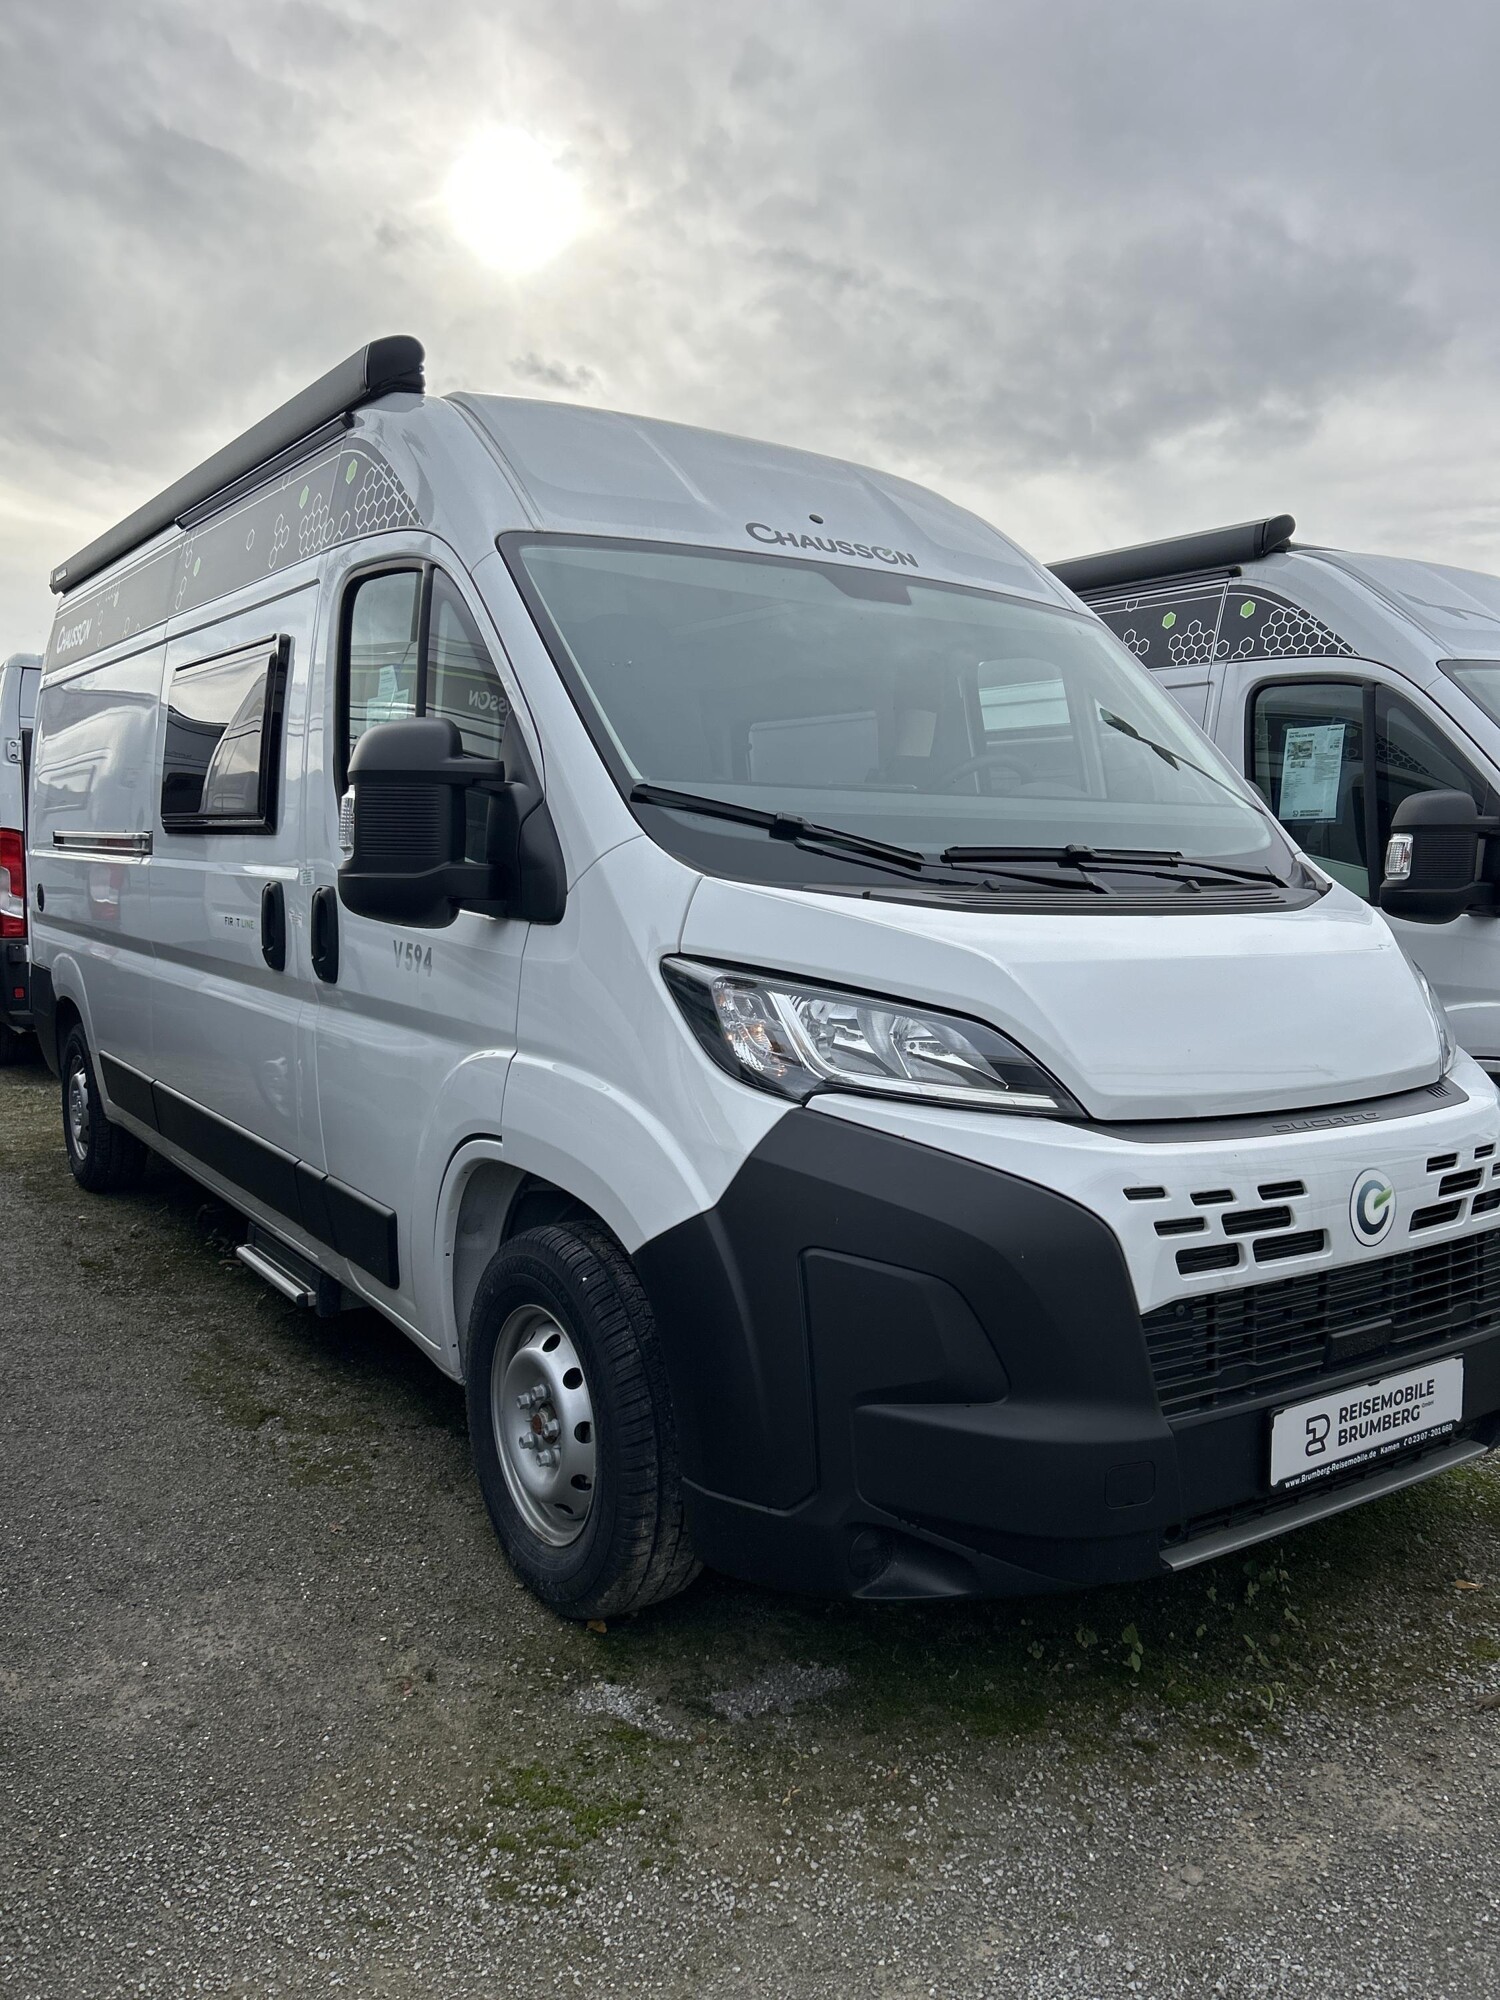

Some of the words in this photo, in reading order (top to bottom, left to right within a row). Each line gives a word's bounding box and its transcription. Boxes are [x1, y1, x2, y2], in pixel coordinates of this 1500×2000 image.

[745, 522, 919, 568] CHAUSSON
[1272, 1112, 1381, 1133] DUCATO
[1338, 1378, 1435, 1425] REISEMOBILE
[1337, 1404, 1421, 1447] BRUMBERG
[1284, 1449, 1377, 1489] www.Brumberg-Reisemobile.de
[1380, 1441, 1400, 1455] Kamen
